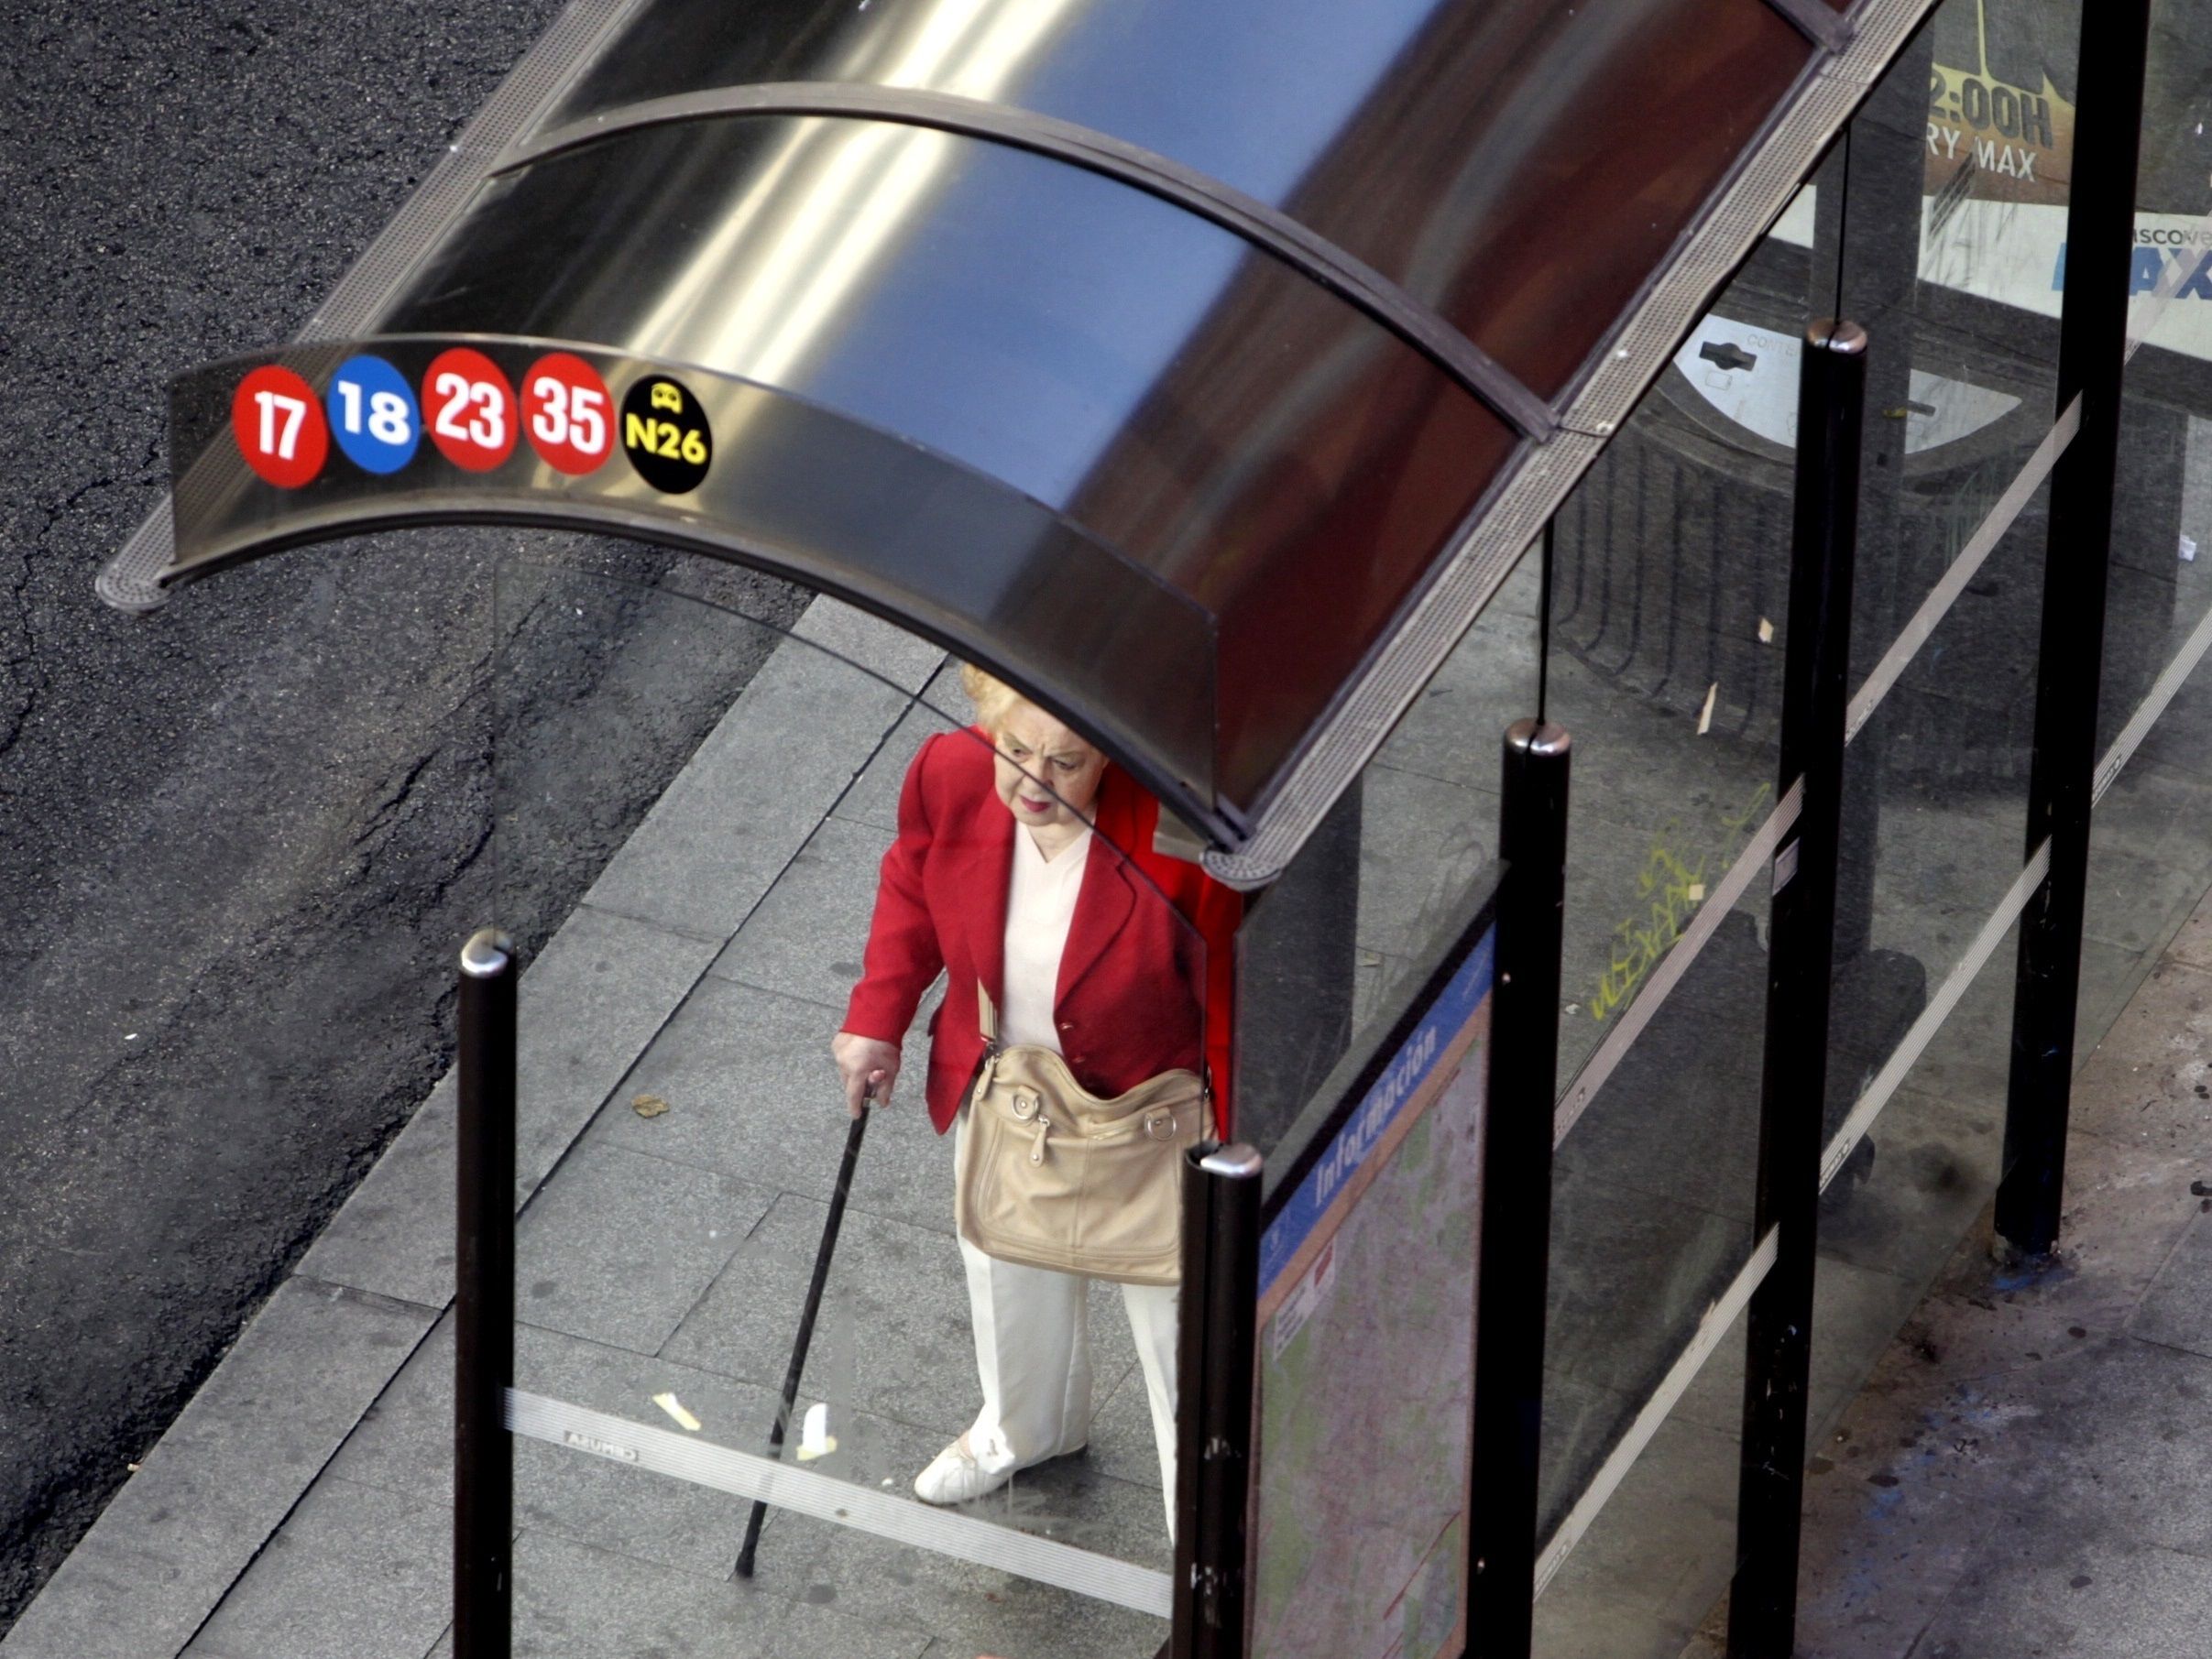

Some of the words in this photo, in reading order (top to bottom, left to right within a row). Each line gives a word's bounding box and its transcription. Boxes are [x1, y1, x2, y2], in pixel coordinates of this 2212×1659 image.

[1974, 136, 2037, 182] MAX
[255, 390, 307, 461] 17
[337, 380, 411, 446] 18
[434, 372, 505, 450] 23
[531, 376, 604, 454] 35
[626, 413, 706, 464] N26
[1316, 1025, 1438, 1208] Información
